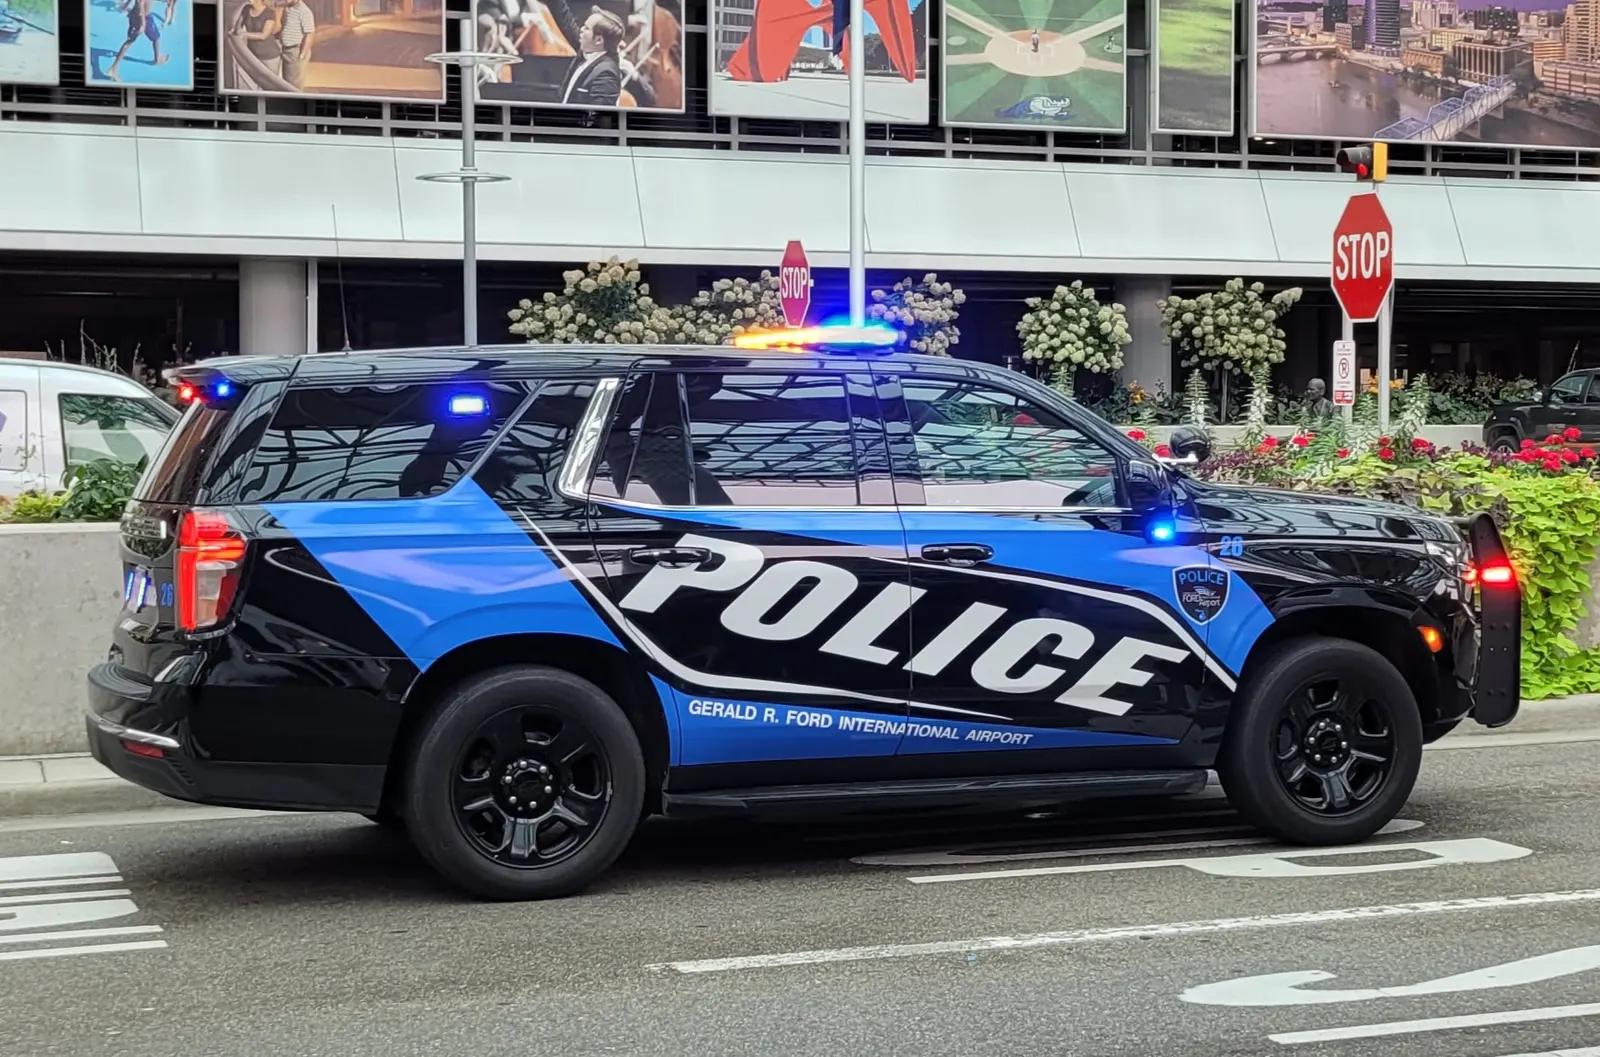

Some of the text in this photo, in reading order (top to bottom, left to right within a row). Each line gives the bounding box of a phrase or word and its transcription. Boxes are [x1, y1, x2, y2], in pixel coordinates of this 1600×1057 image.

[1336, 231, 1390, 281] STOP
[782, 267, 808, 299] STOP
[161, 582, 174, 607] 26
[1179, 570, 1226, 586] POLICE
[619, 533, 1192, 716] POLICE
[688, 700, 1034, 745] GERALD R. FORD INTERNATIONAL AIRPORT
